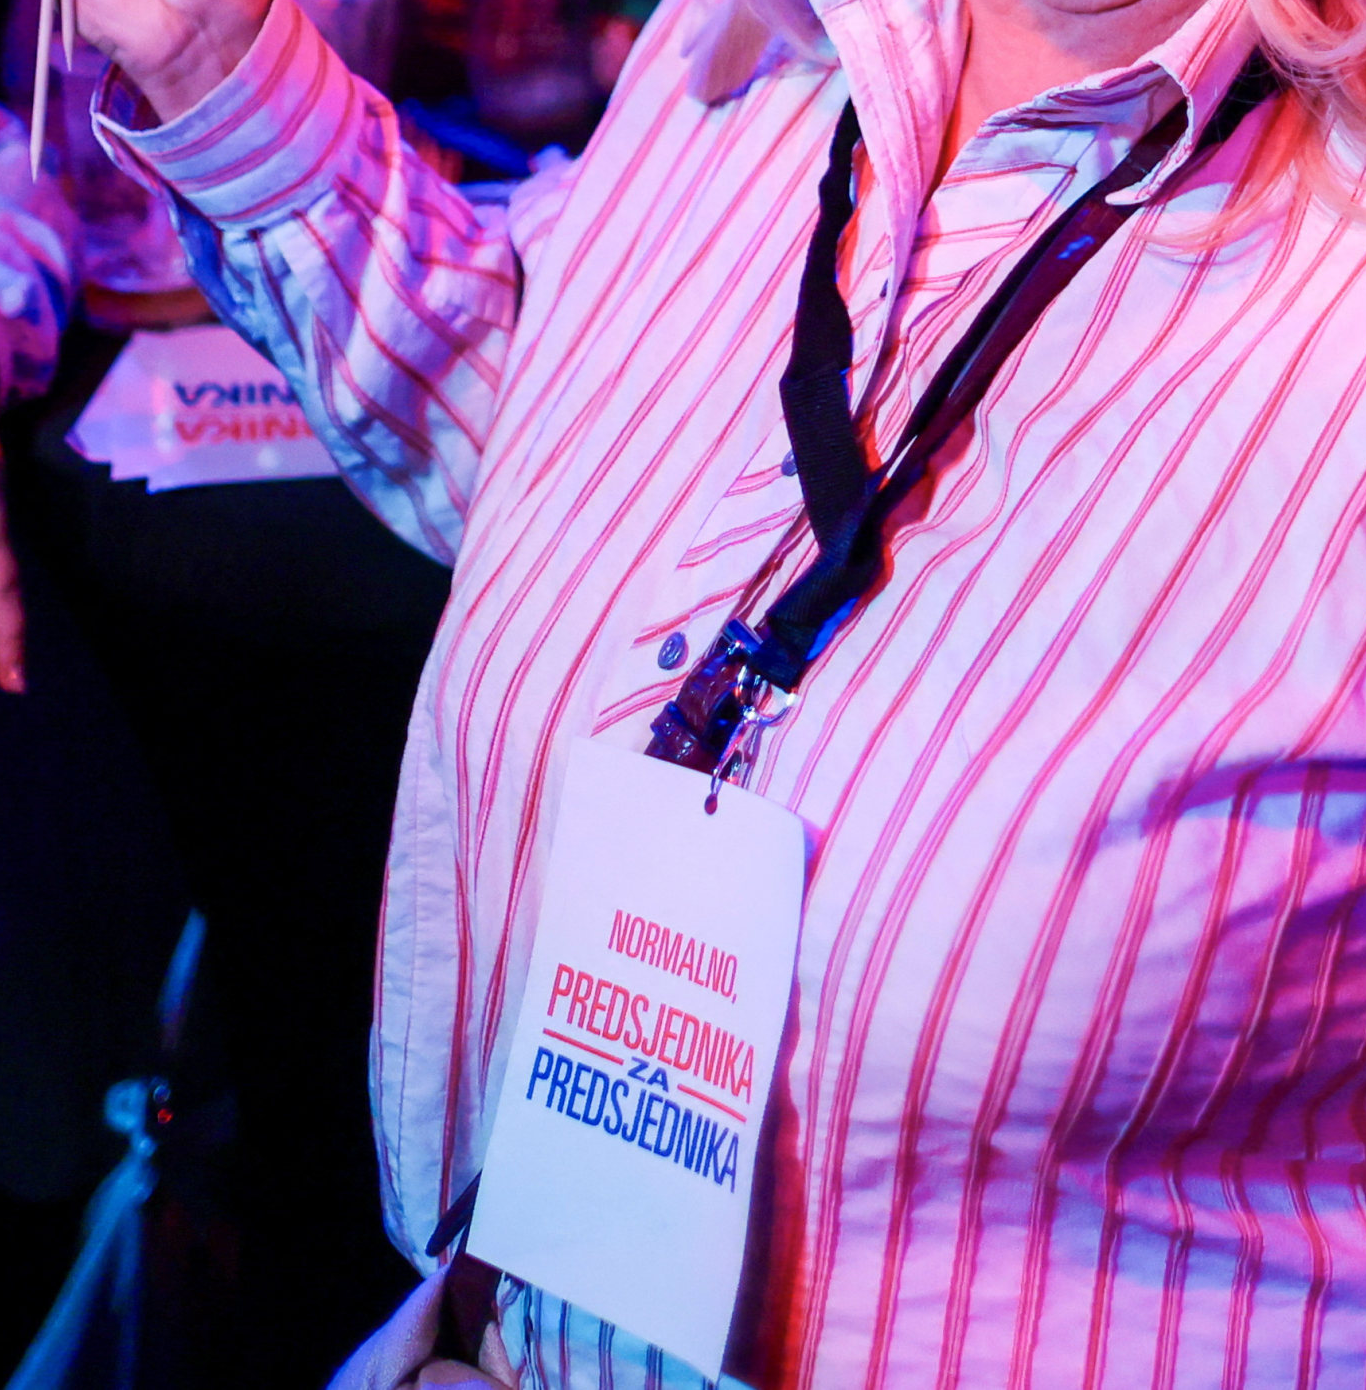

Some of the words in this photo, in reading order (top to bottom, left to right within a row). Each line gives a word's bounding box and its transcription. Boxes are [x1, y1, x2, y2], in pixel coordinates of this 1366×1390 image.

[607, 908, 739, 1004] NORMALNO,
[546, 962, 756, 1104] PREDSJEDNIKA
[626, 1056, 671, 1092] ZA
[525, 1045, 740, 1193] PREDSJEDNIKA
